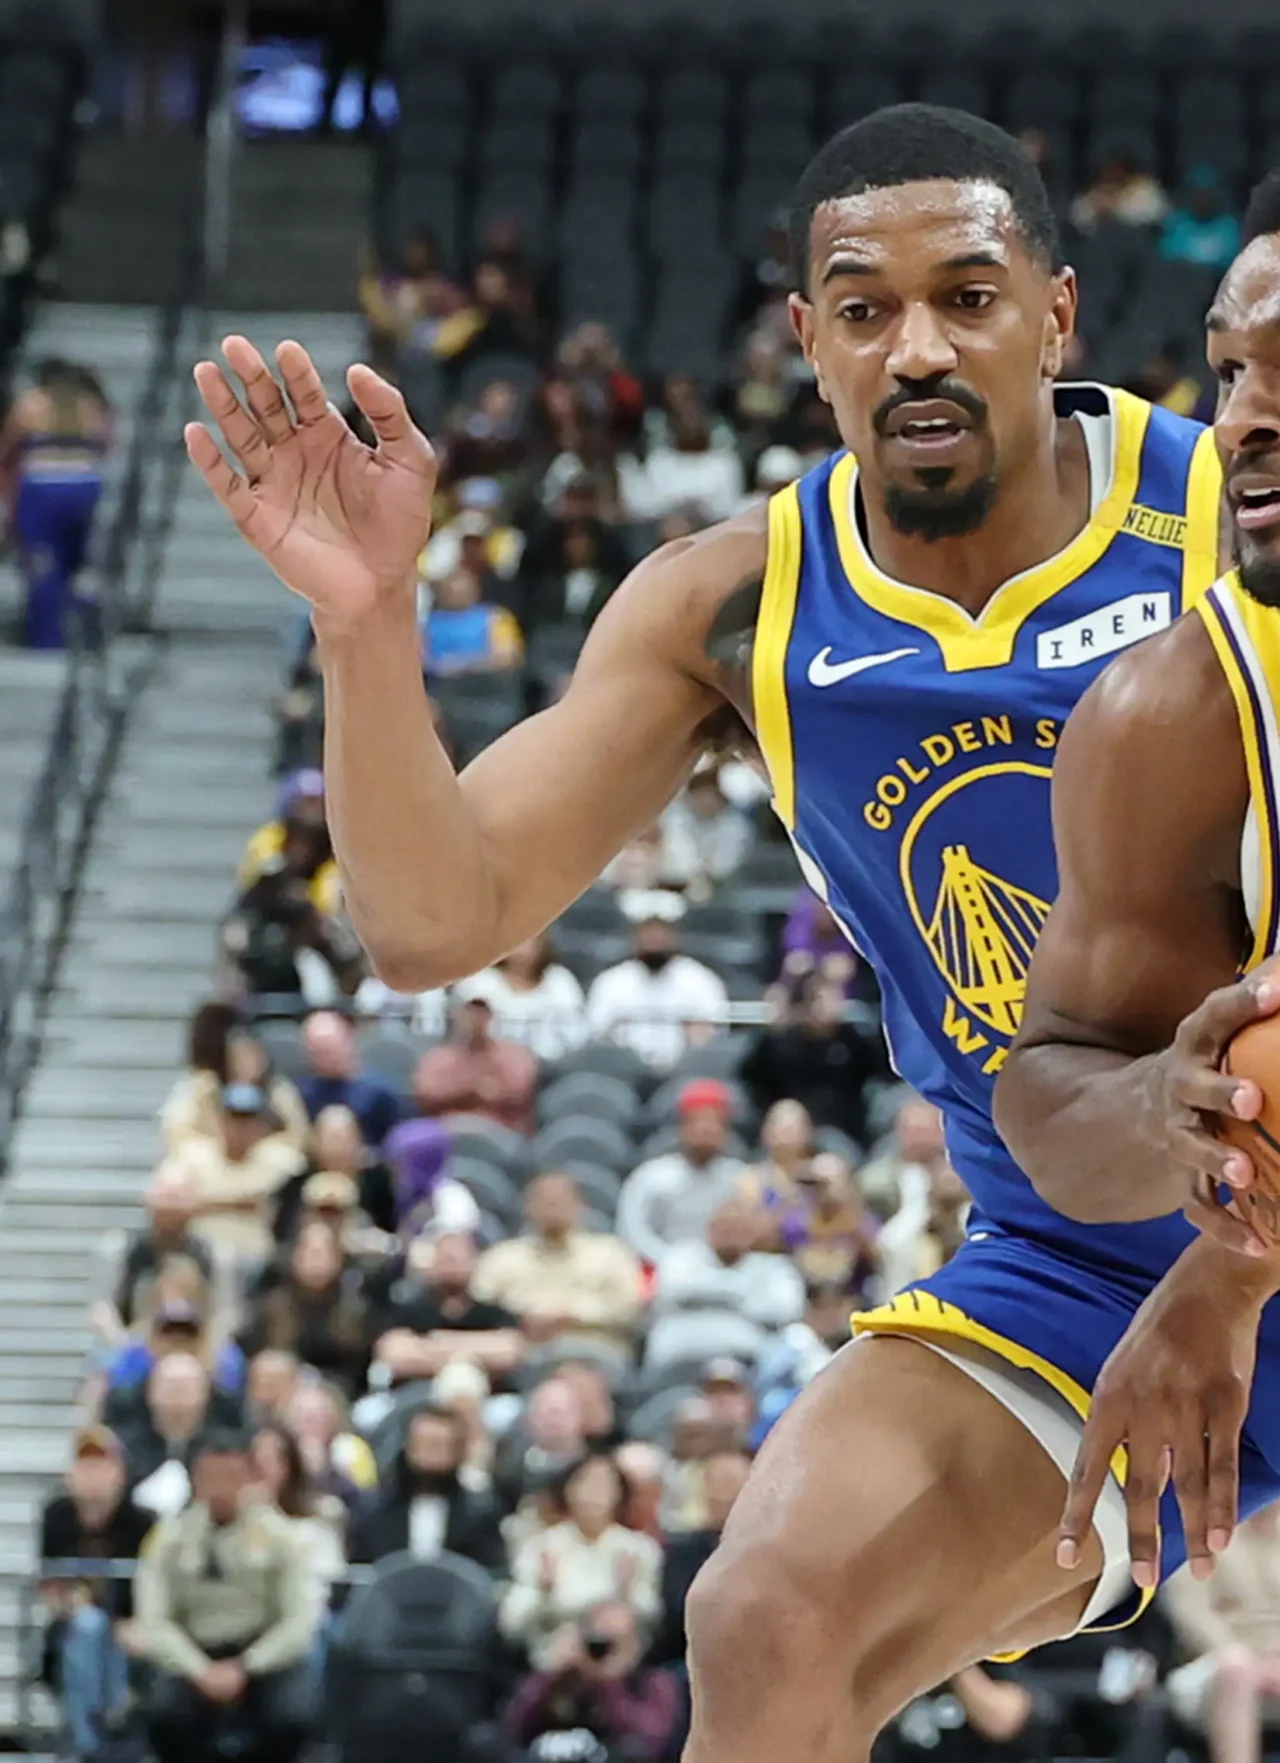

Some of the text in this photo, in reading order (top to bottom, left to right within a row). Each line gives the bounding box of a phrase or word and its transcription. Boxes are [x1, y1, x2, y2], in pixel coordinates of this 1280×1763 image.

[1121, 508, 1188, 545] NELLIE
[1049, 601, 1157, 660] IREN
[863, 713, 1014, 831] GOLDEN
